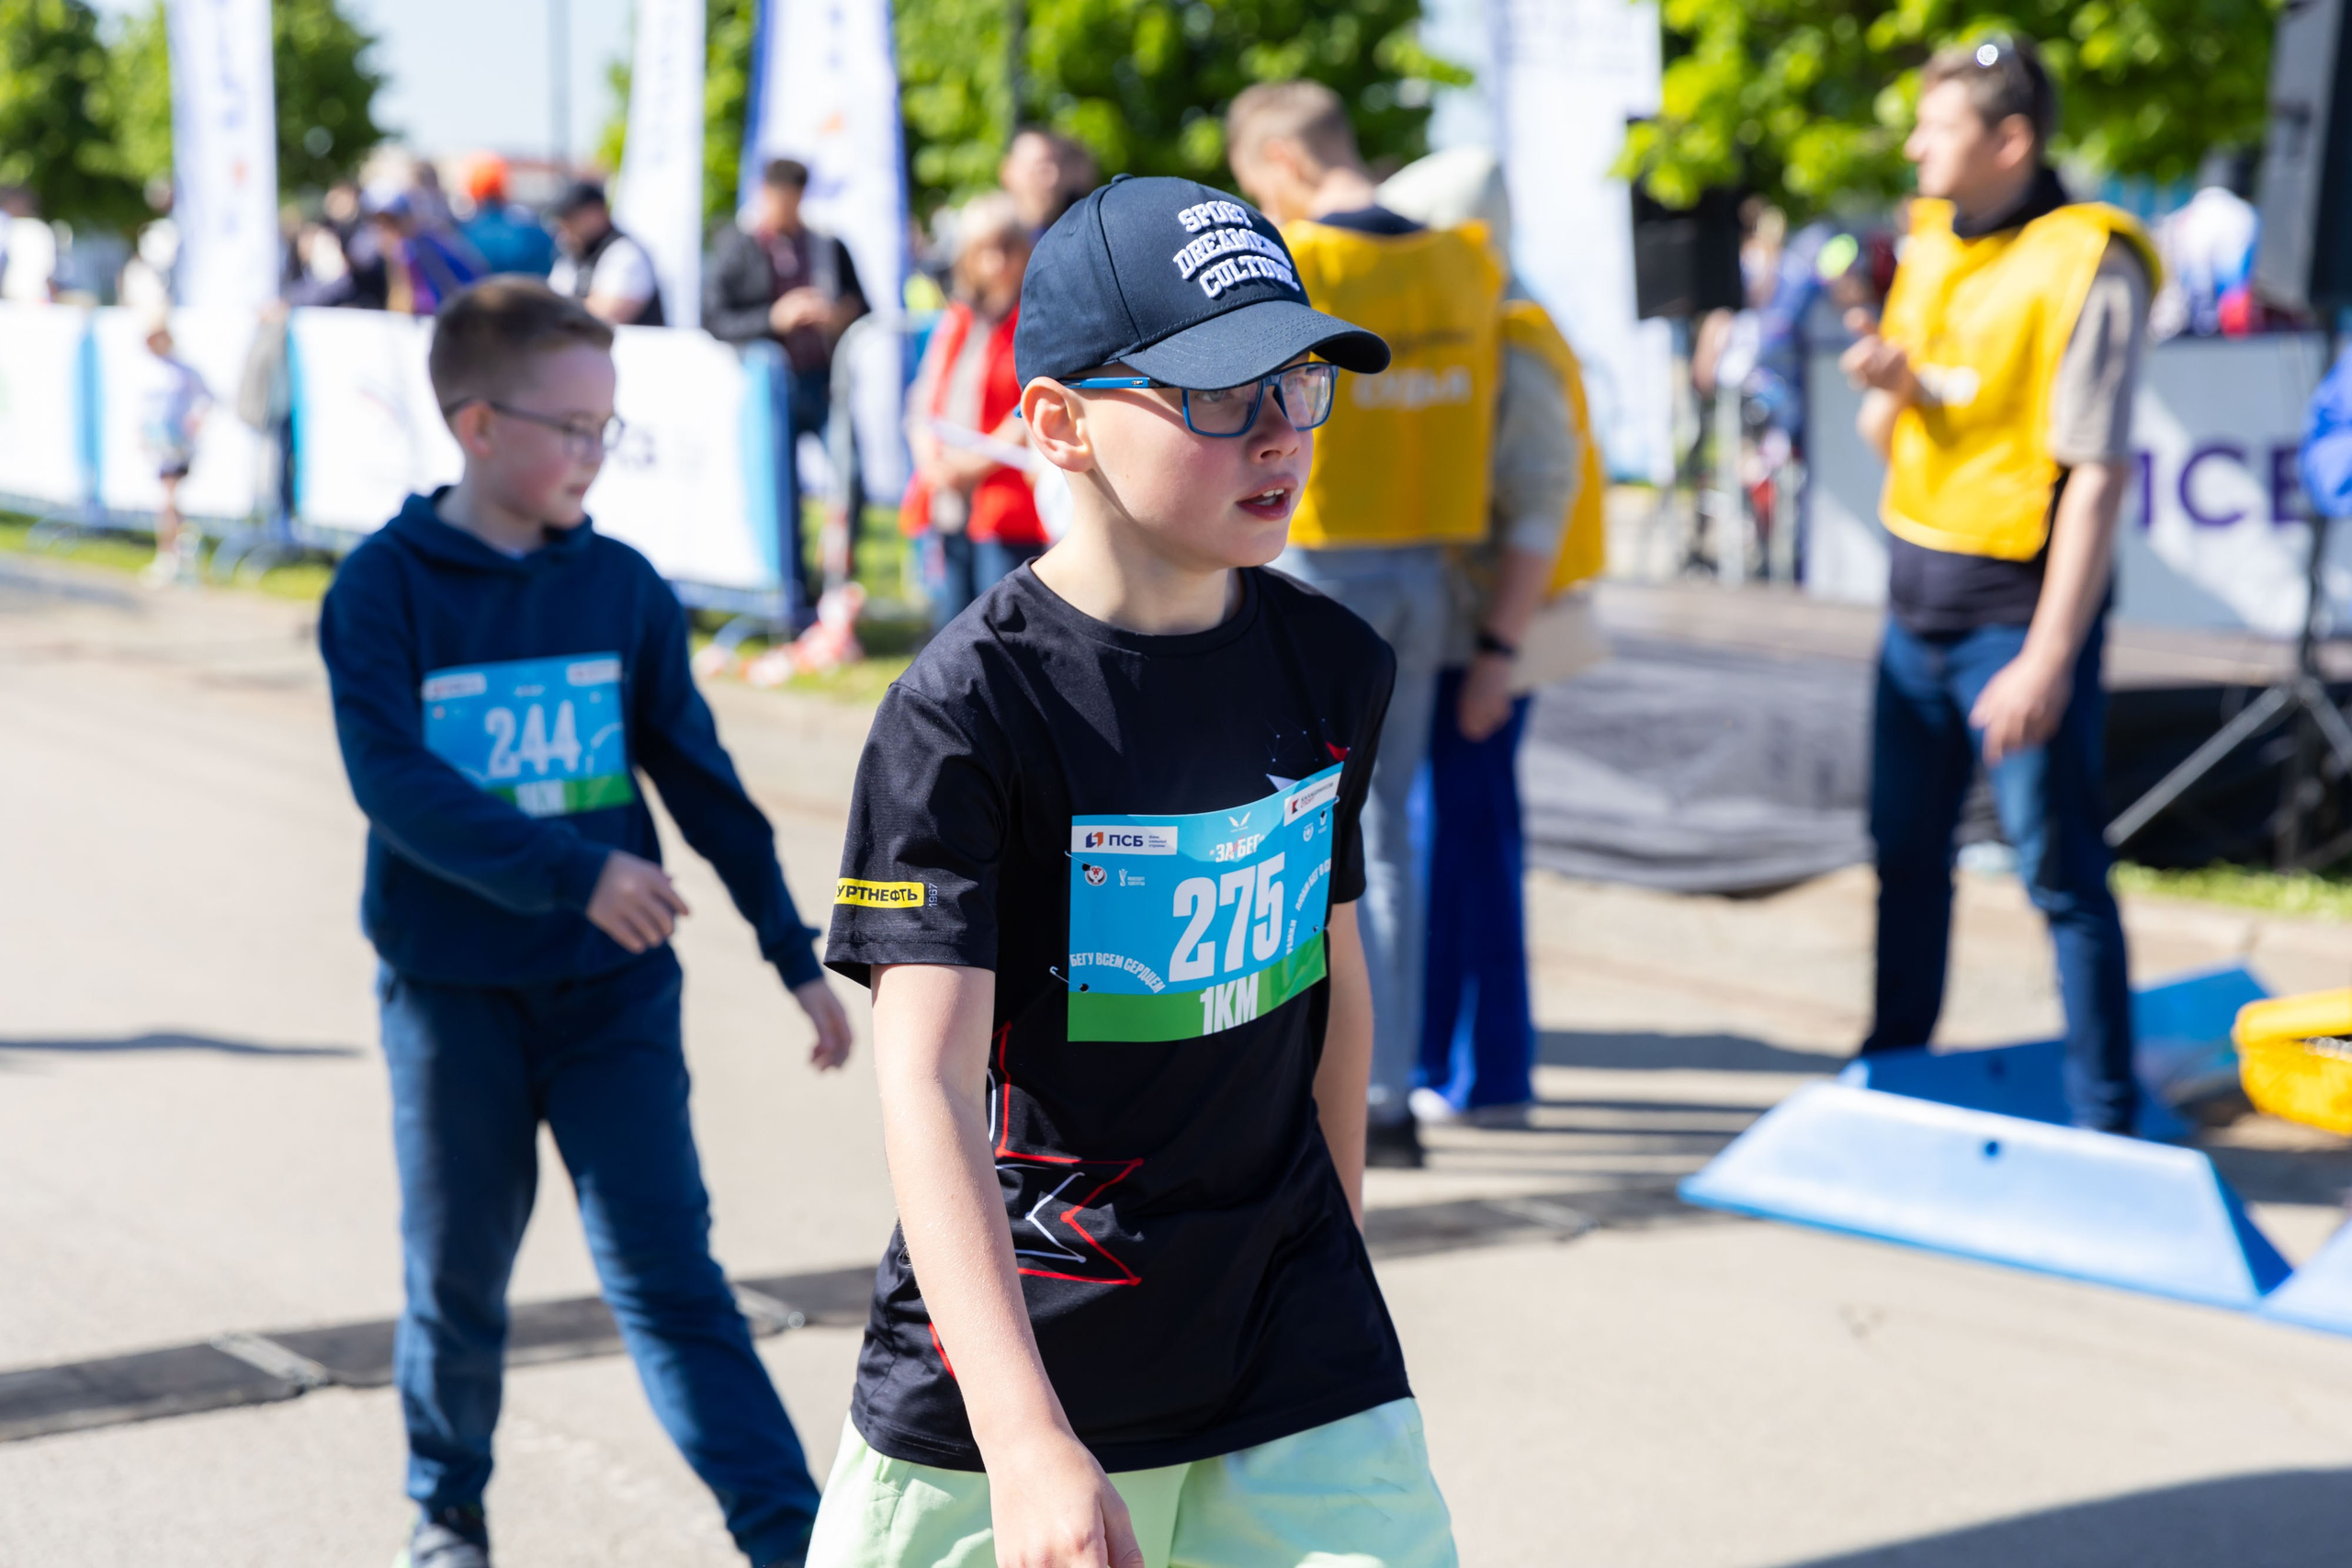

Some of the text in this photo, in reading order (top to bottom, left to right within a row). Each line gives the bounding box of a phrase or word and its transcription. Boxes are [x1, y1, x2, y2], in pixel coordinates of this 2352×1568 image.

[1178, 200, 1253, 233] SPORT
[484, 699, 582, 777] 244
[1109, 834, 1144, 847] ПСБ
[837, 886, 918, 902] УРТНЕФТЬ
[928, 883, 938, 908] 1967
[1169, 852, 1285, 983] 275
[1069, 952, 1166, 994] БЕГУ ВСЕМ СЕРДЦЕМ
